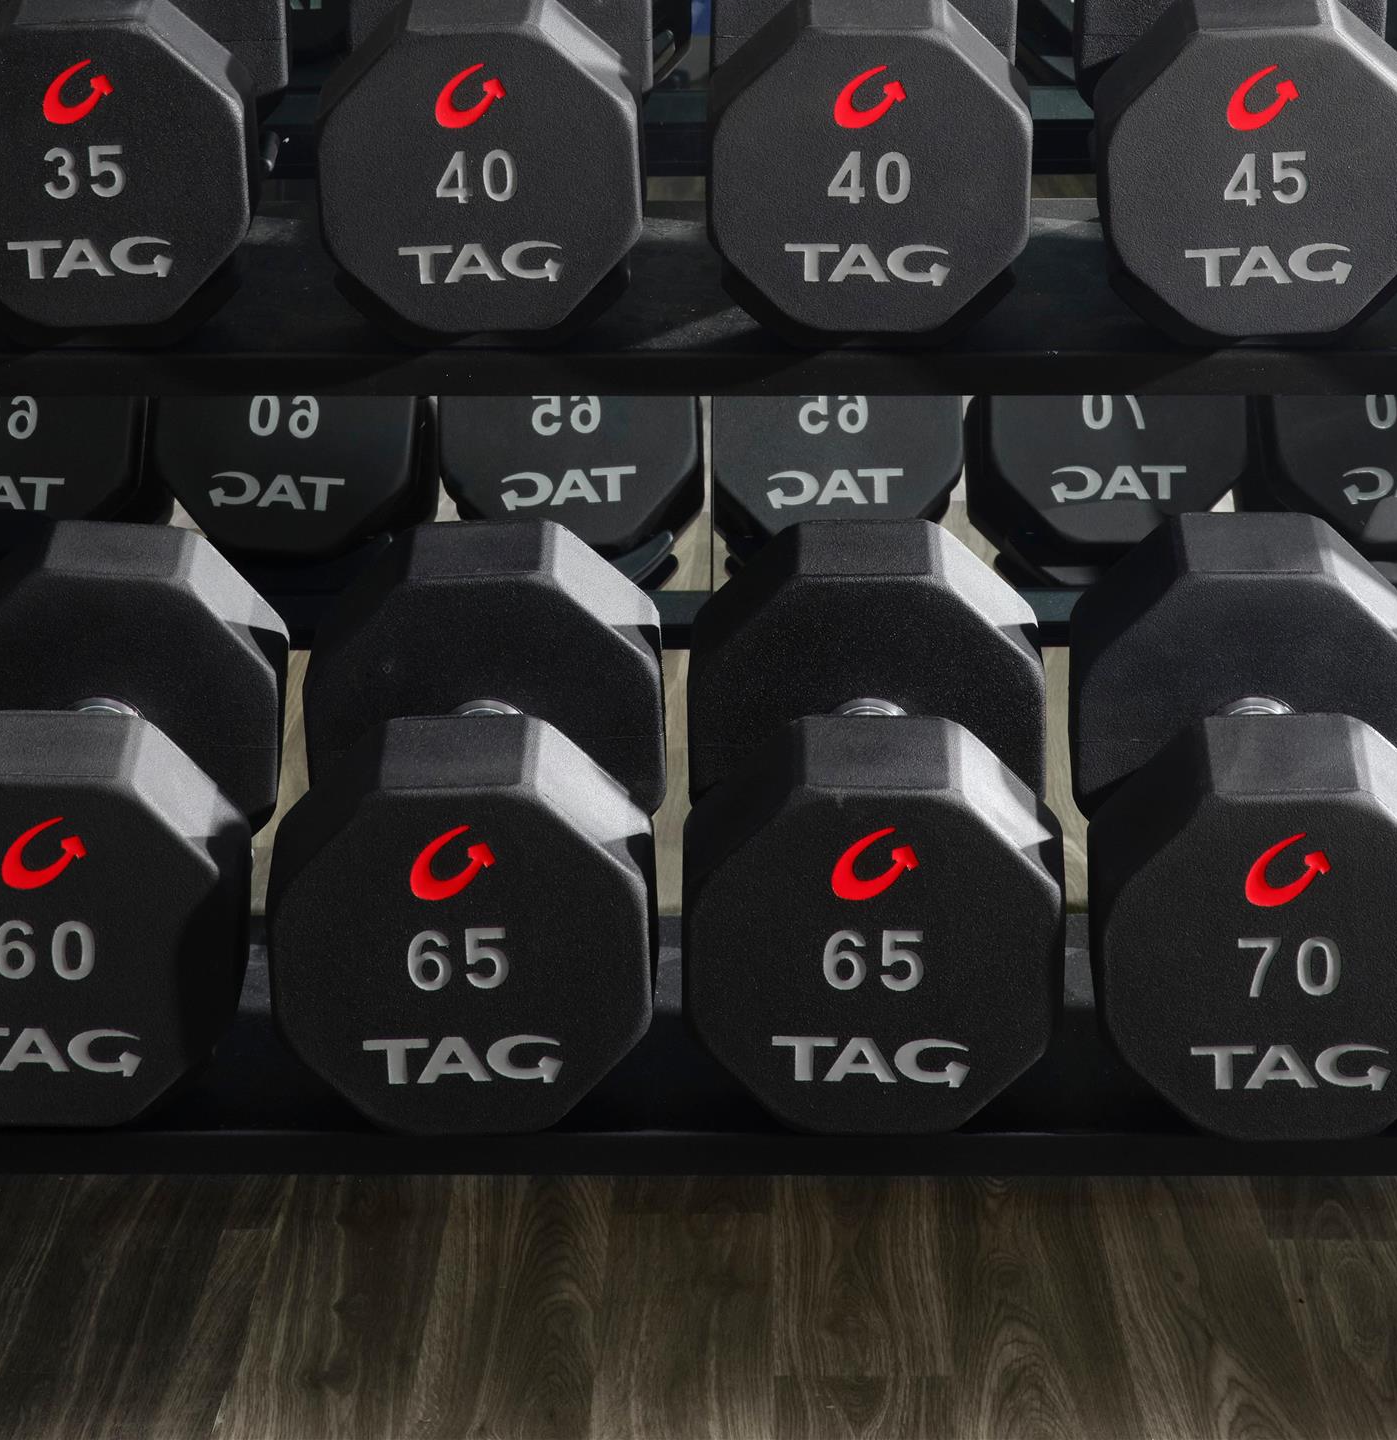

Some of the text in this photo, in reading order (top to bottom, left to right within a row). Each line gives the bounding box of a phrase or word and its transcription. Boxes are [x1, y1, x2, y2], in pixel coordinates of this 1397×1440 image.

[42, 144, 125, 201] 35
[434, 148, 515, 205] 40
[826, 149, 912, 206] 40
[1222, 150, 1308, 208] 45
[5, 234, 173, 281] TAG
[397, 239, 561, 286] TAG
[783, 242, 950, 288] TAG
[1183, 241, 1353, 289] TAG
[405, 926, 507, 993] 65
[821, 928, 922, 993] 65
[1236, 937, 1338, 999] 70
[361, 1033, 562, 1086] TAG
[770, 1034, 969, 1090] TAG
[1189, 1042, 1389, 1092] TAG
